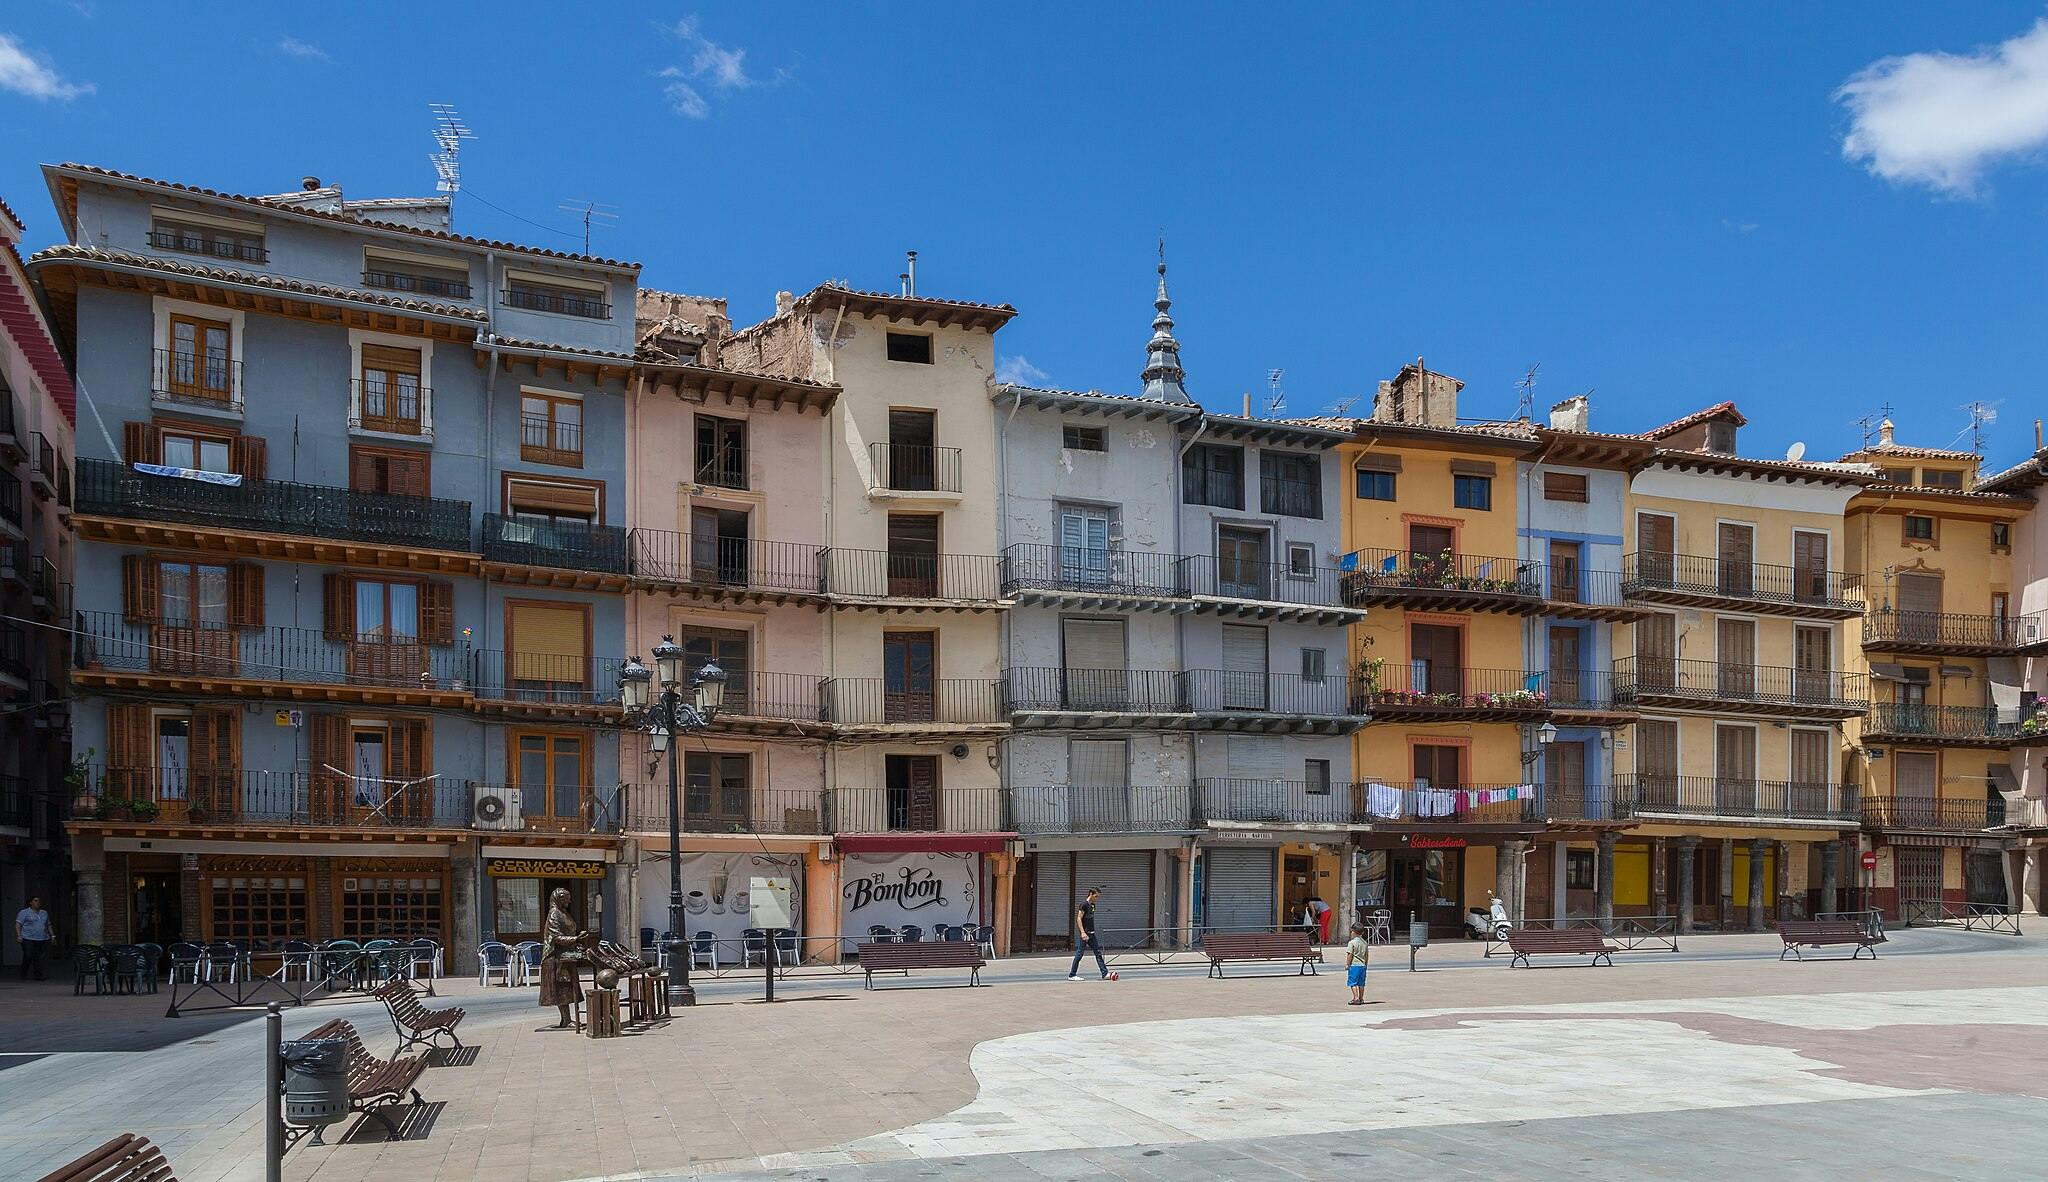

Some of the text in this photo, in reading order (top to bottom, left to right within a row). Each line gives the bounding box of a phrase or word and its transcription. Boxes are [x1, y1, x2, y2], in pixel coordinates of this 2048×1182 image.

[493, 860, 600, 874] SERVICAR 25
[871, 872, 885, 884] El
